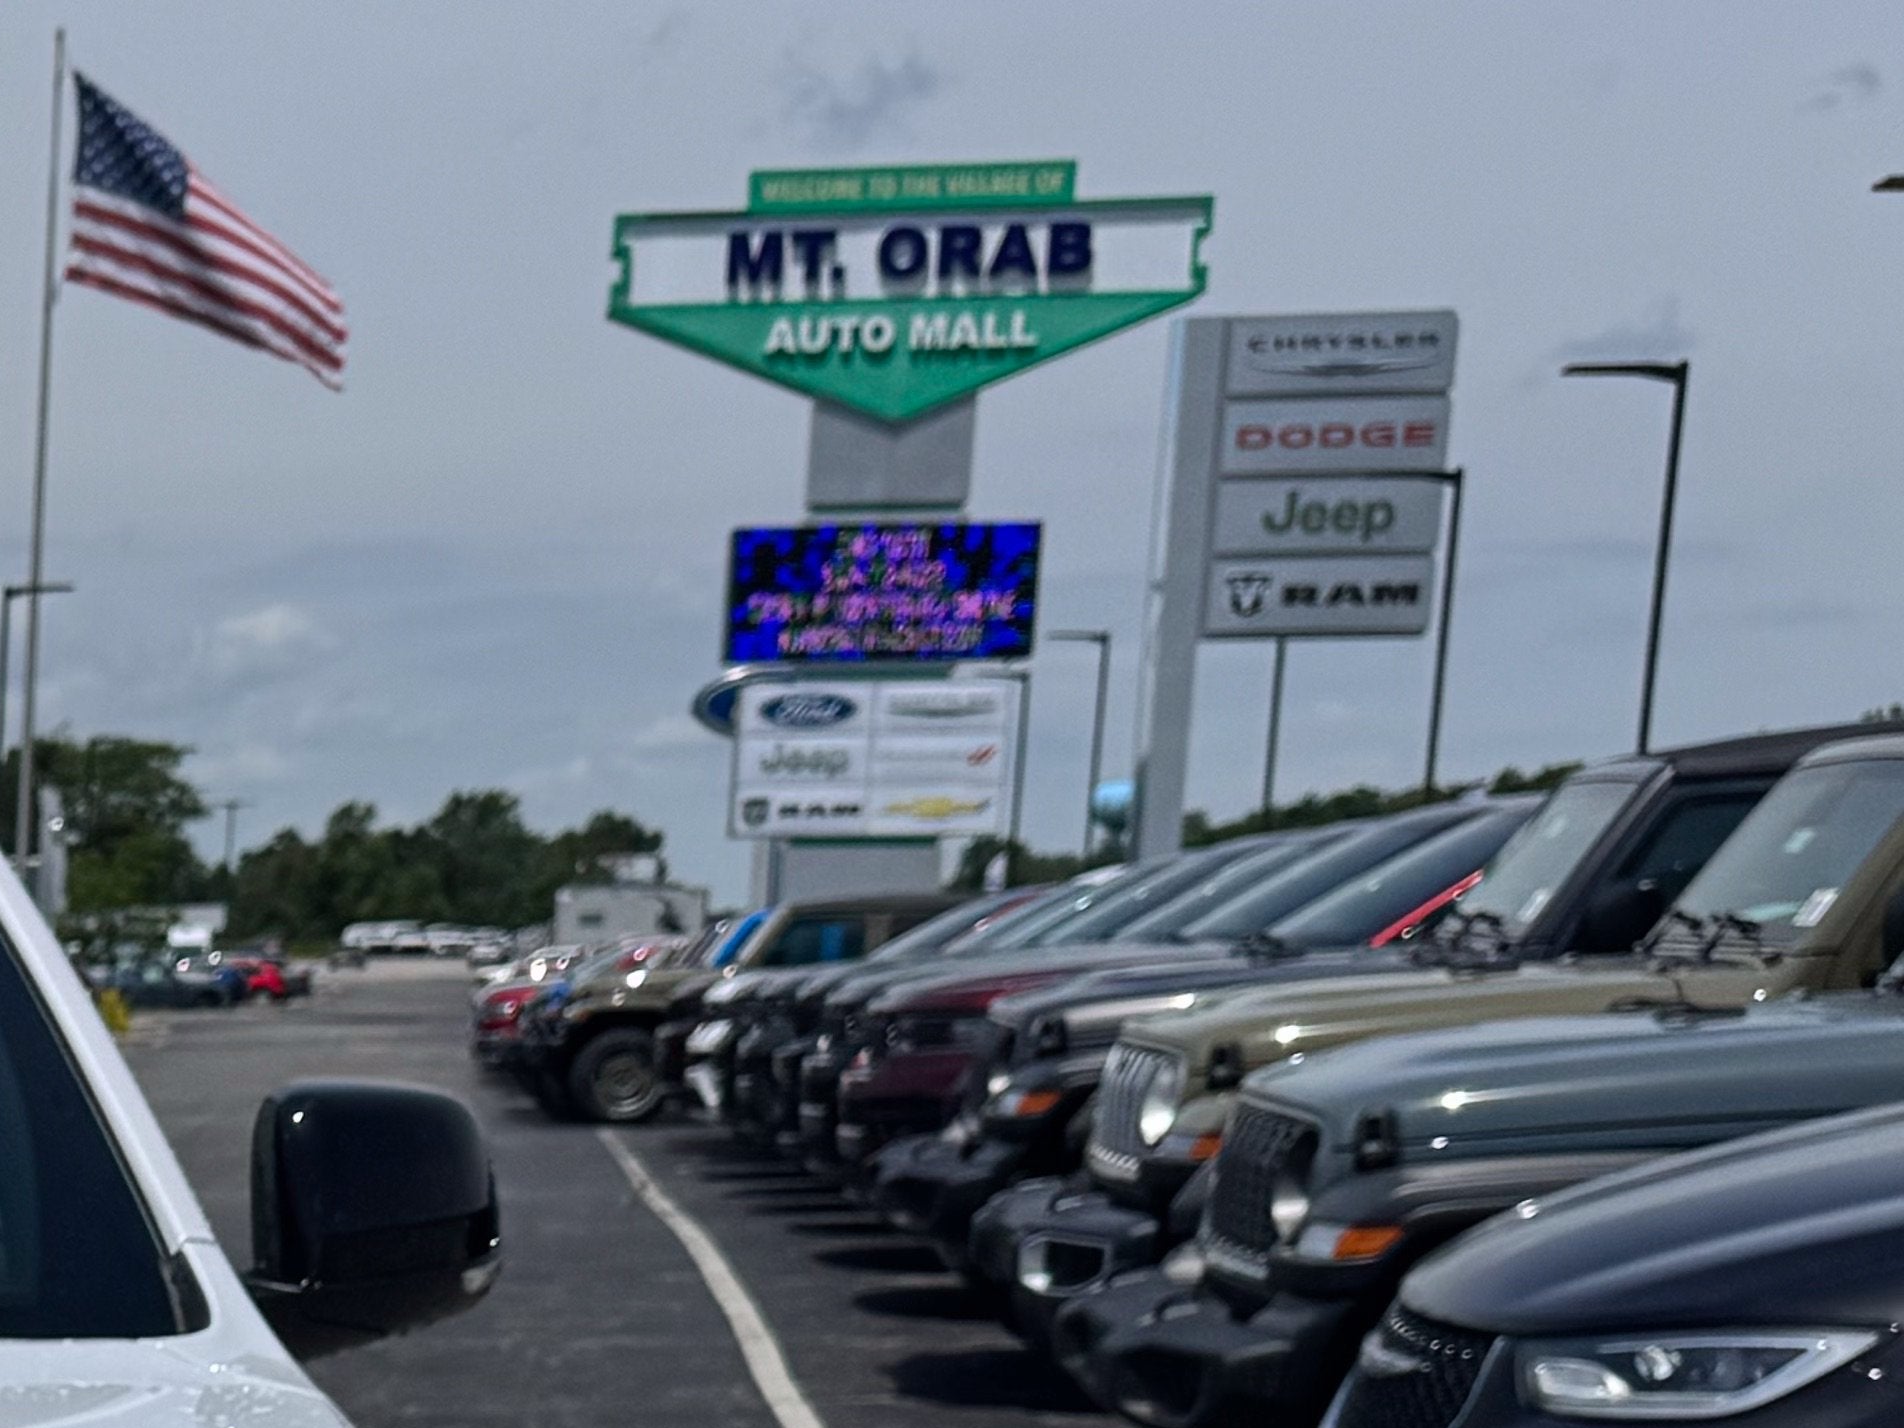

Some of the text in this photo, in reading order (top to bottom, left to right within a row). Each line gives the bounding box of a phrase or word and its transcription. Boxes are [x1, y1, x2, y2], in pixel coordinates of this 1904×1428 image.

[726, 220, 1092, 290] MT. ORAB
[764, 309, 1038, 356] AUTO MALL
[1246, 332, 1440, 354] CHRYSLER
[1235, 421, 1436, 451] DODGE
[1260, 491, 1396, 543] Jeep
[1280, 580, 1420, 608] RAM
[759, 744, 850, 778] Jeep
[778, 802, 862, 819] RAM
